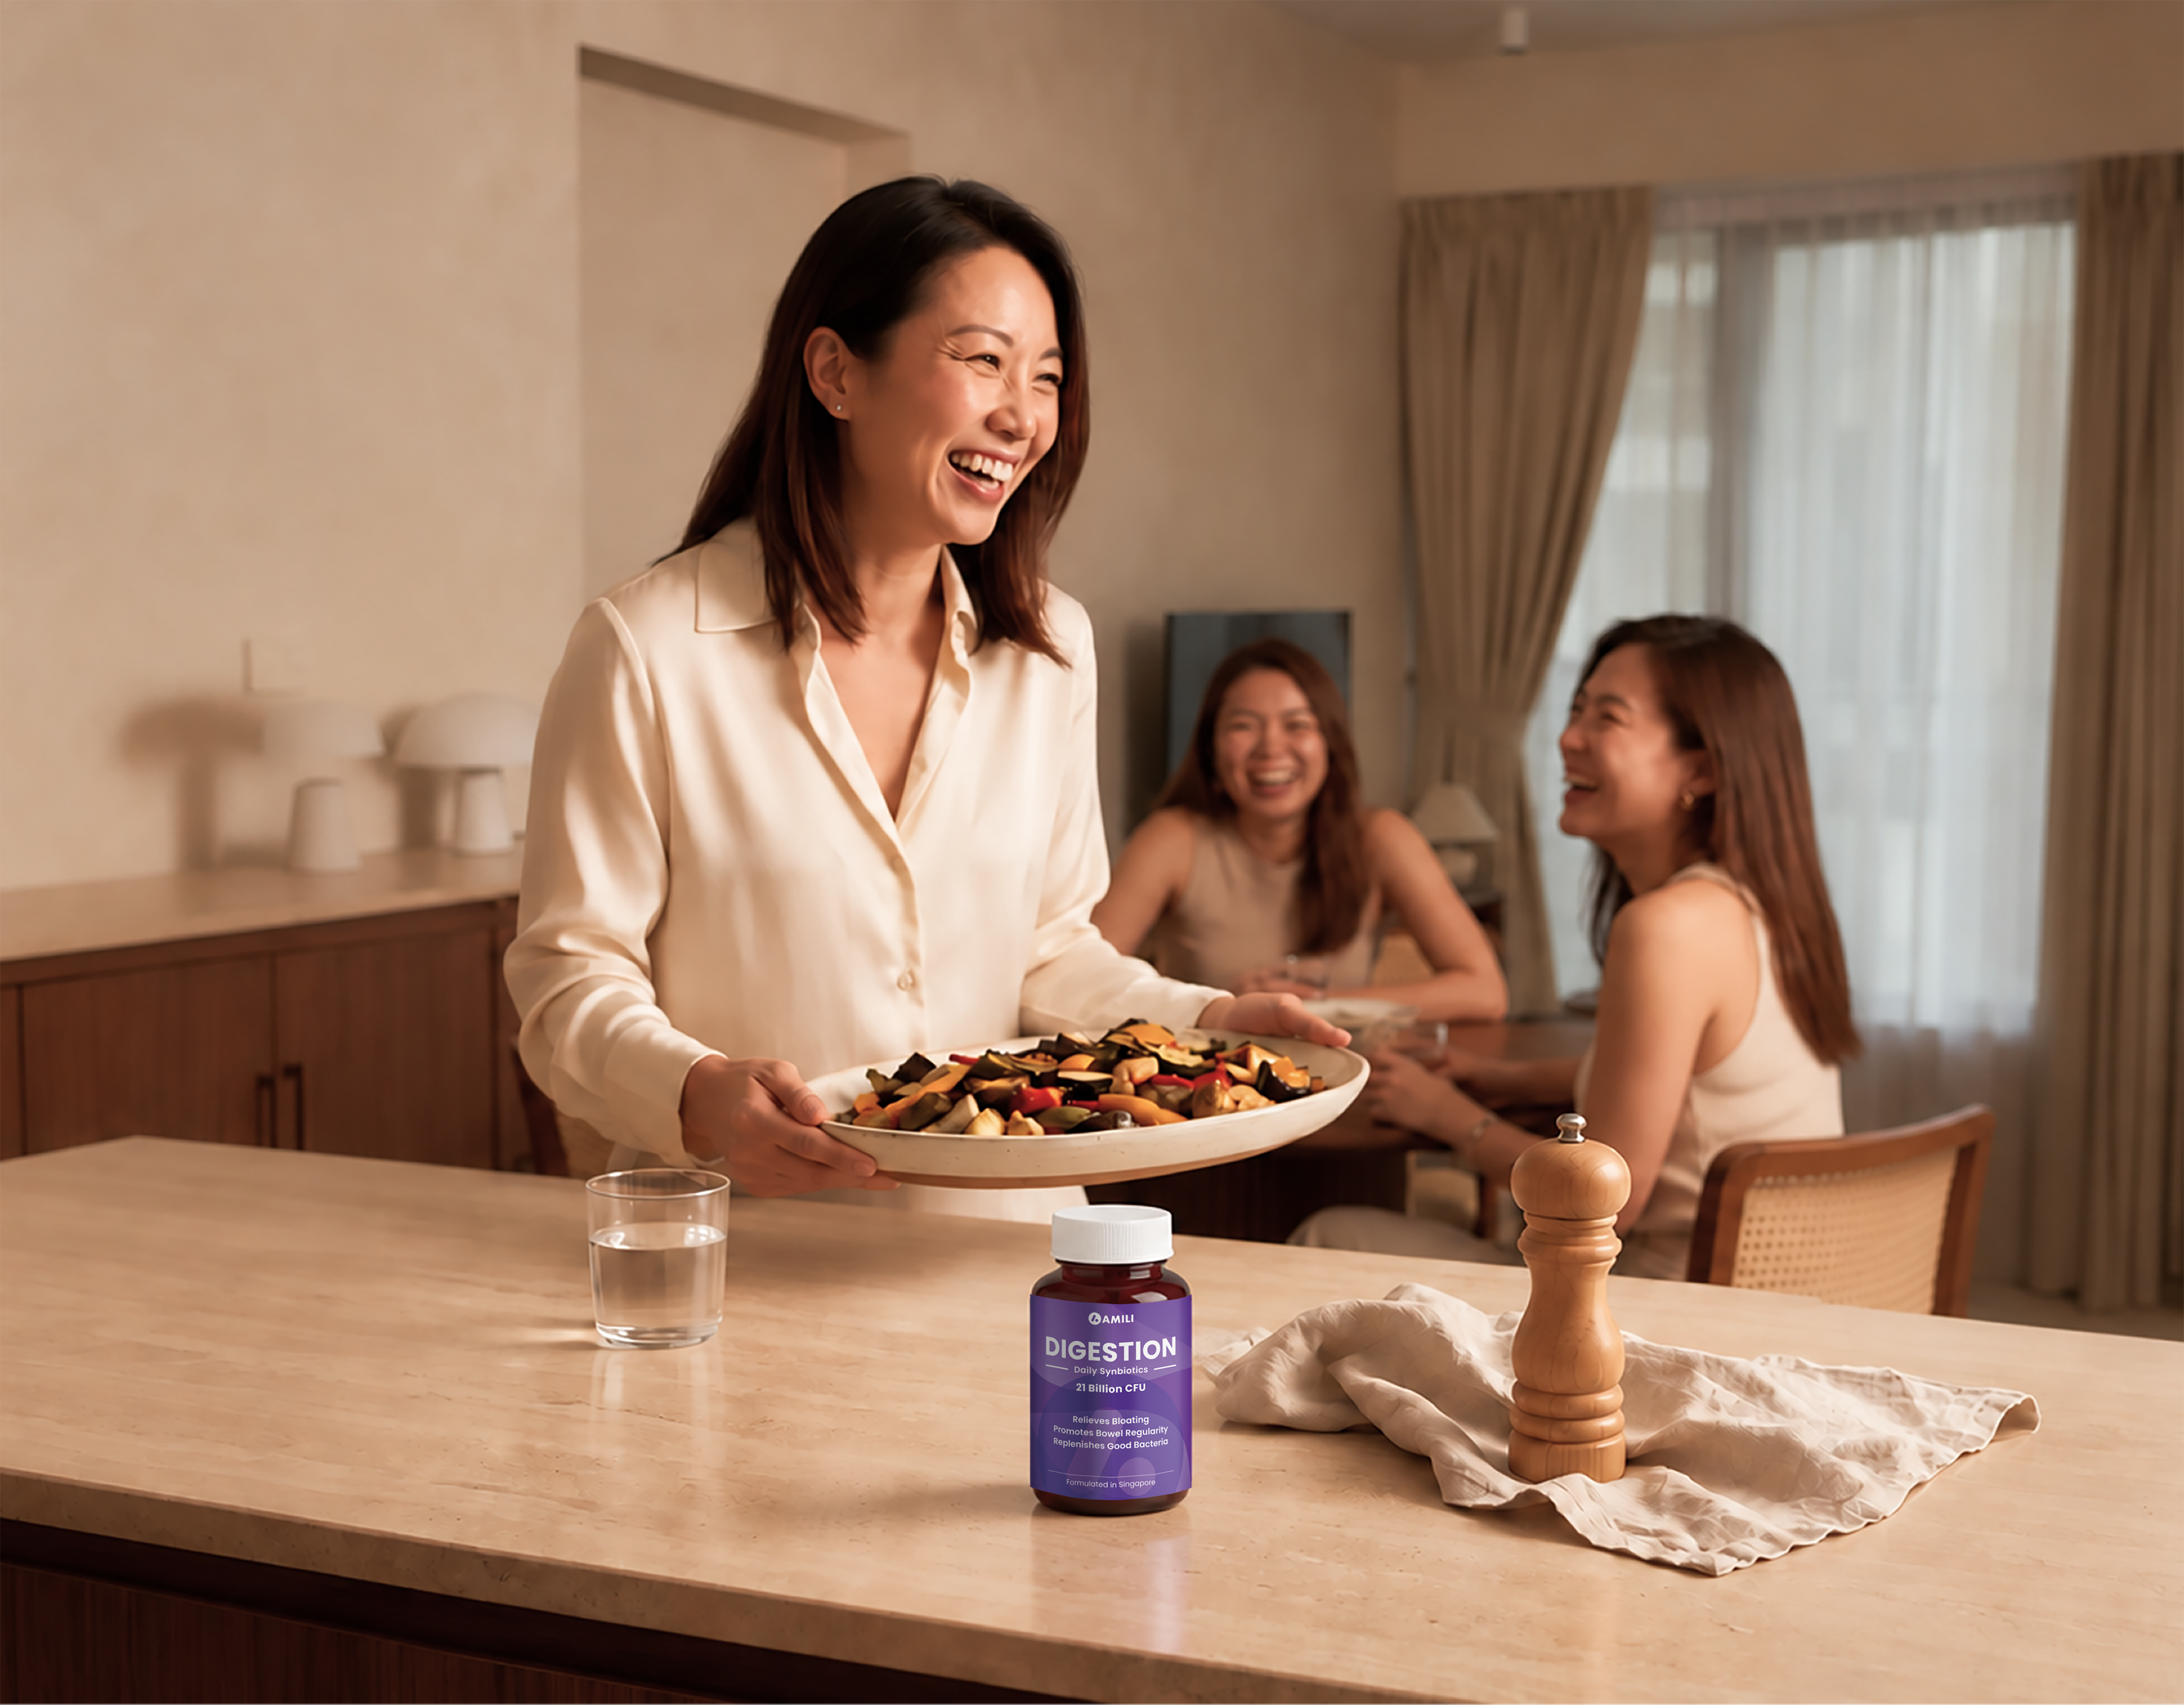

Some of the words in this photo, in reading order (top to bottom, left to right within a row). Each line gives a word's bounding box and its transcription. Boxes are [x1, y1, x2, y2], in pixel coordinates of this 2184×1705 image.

[1102, 1314, 1134, 1323] AMILI
[1046, 1336, 1176, 1362] DIGESTION
[1075, 1366, 1097, 1376] Daily
[1100, 1366, 1148, 1377] Synbiotics
[1089, 1384, 1122, 1393] Billion
[1126, 1383, 1145, 1392] CFU
[1073, 1416, 1109, 1425] Relieves
[1112, 1416, 1149, 1425] Bloating
[1054, 1425, 1093, 1436] Promotes
[1126, 1424, 1168, 1437] Regularity
[1054, 1438, 1105, 1449] Replenishes
[1134, 1437, 1168, 1448] Bacteria
[1067, 1479, 1108, 1488] Formulated
[1119, 1480, 1155, 1489] Singapore
